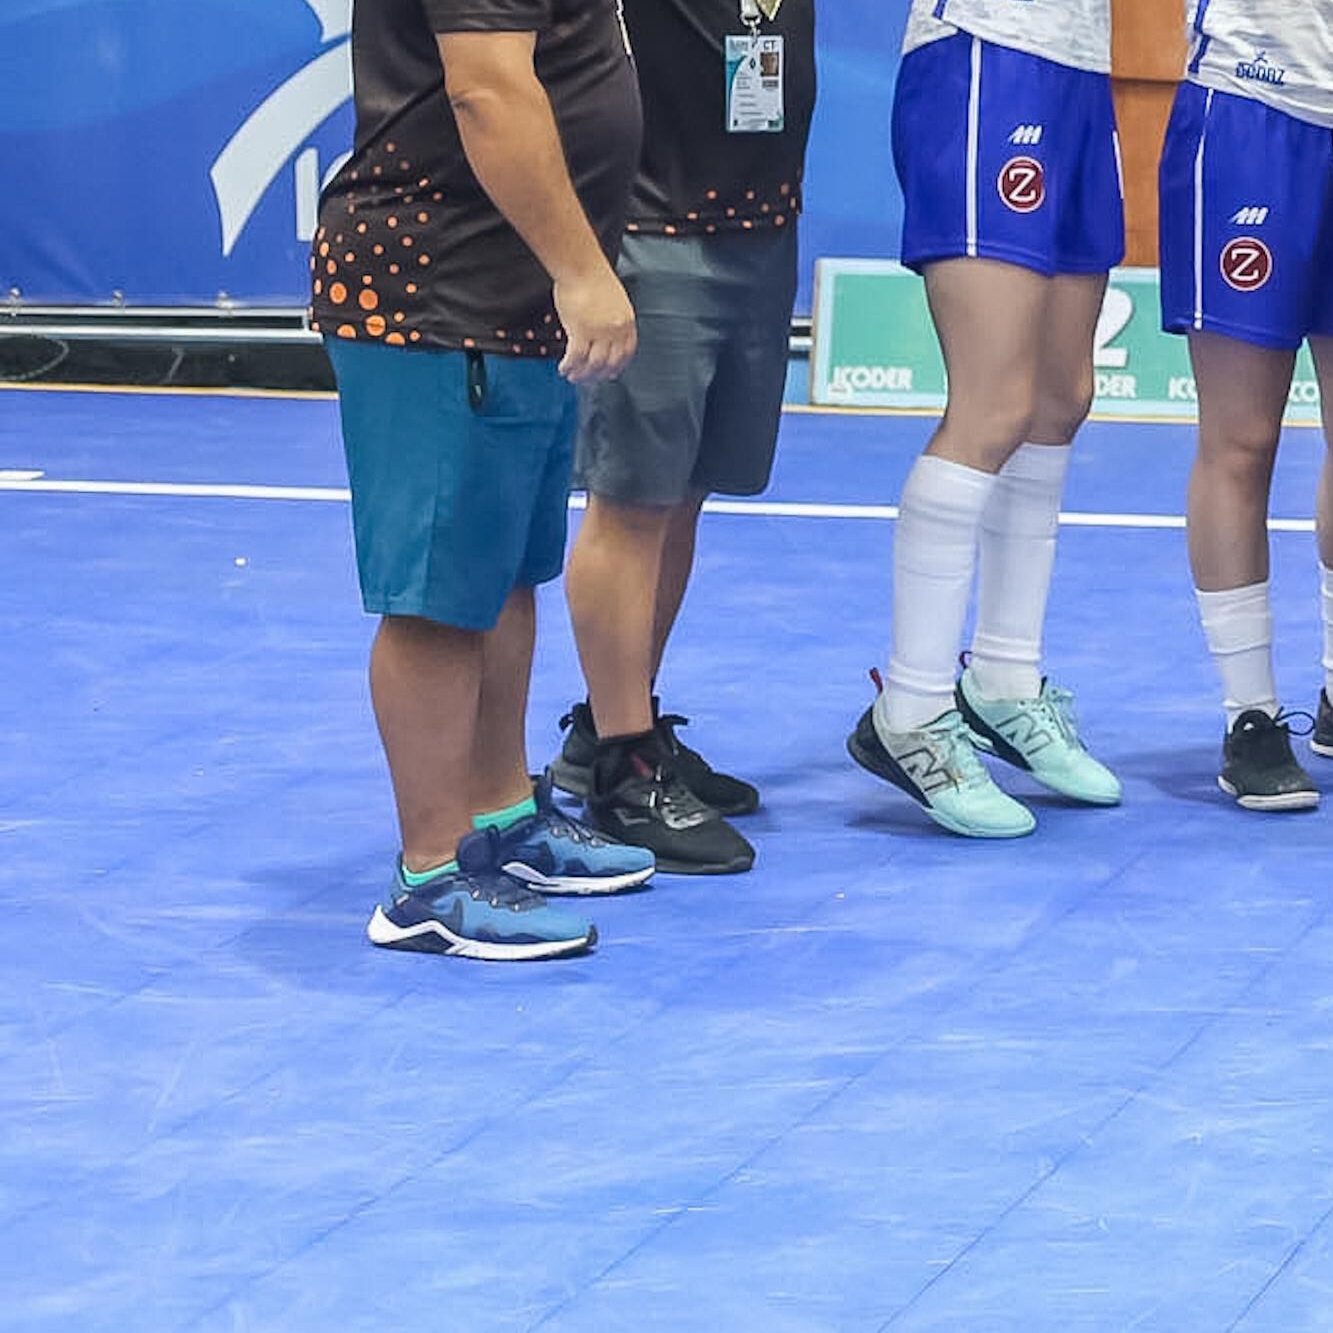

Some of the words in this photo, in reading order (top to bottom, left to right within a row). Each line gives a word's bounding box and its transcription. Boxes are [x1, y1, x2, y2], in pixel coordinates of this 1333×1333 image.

[1009, 168, 1037, 202] Z
[1230, 248, 1260, 281] Z
[1093, 286, 1133, 367] 2
